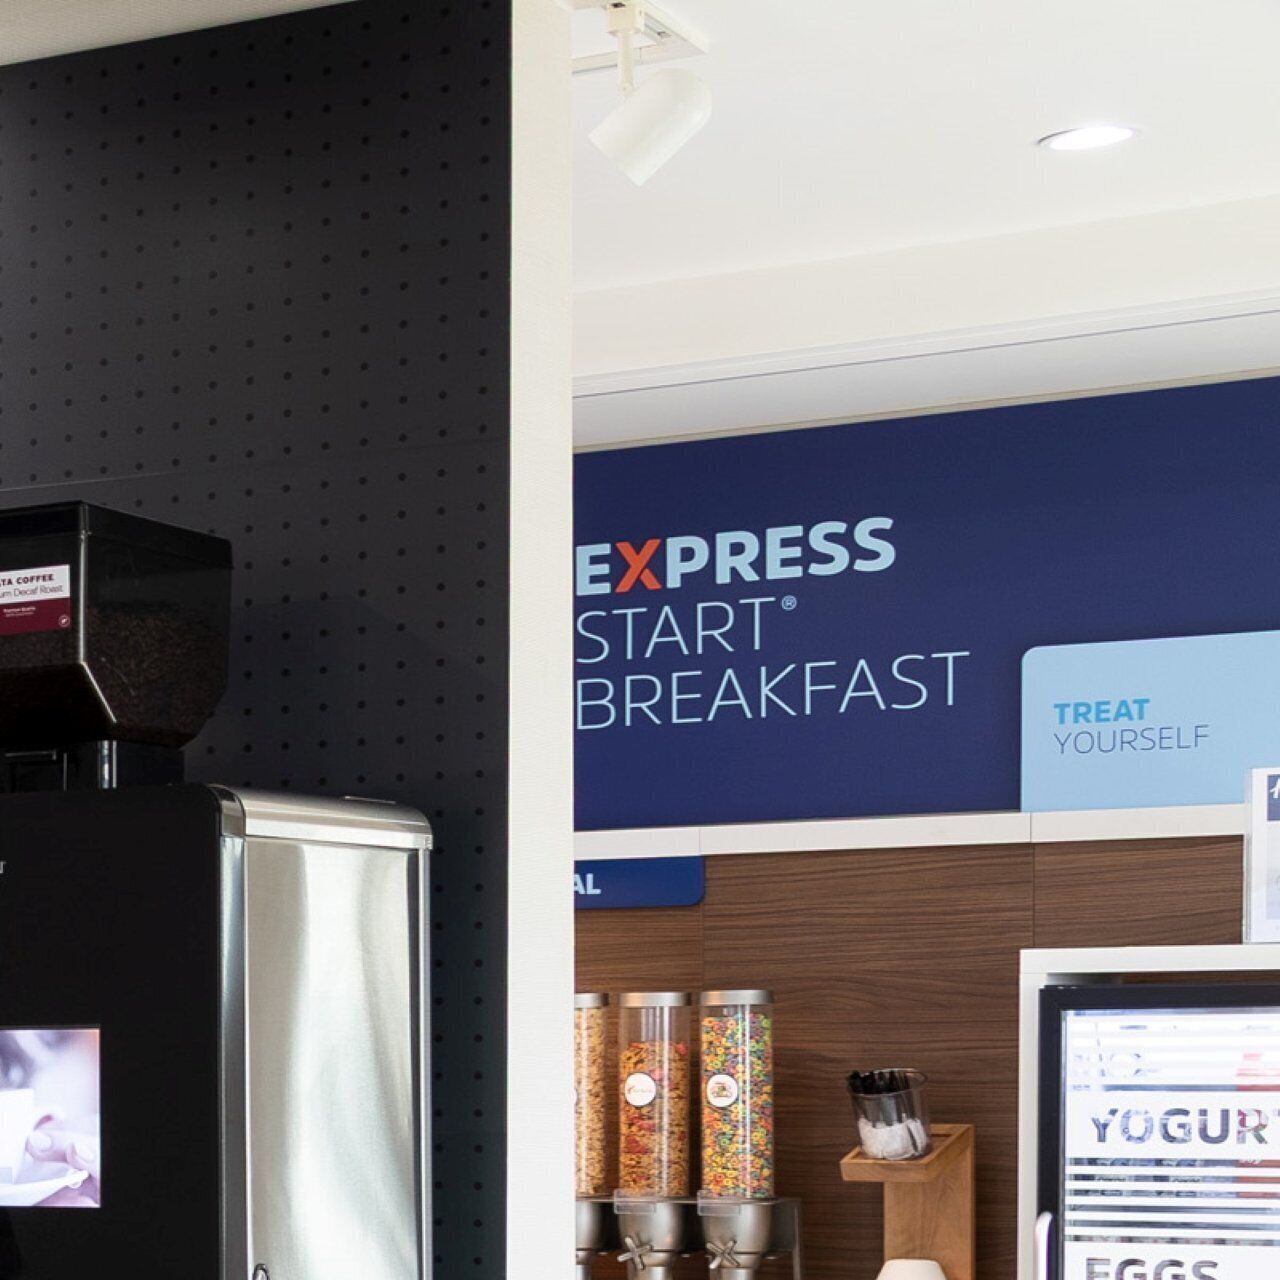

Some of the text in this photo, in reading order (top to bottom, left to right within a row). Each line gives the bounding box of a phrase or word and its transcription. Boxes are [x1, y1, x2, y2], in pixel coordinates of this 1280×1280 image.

[575, 516, 896, 596] EXPRESS
[13, 586, 38, 597] Decaf
[39, 584, 65, 594] Roast
[16, 573, 55, 584] COFFEE
[576, 651, 970, 730] BREAKFAST
[1053, 698, 1150, 725] TREAT
[1053, 724, 1209, 755] YOURSELF
[1091, 1108, 1280, 1144] YOGUR
